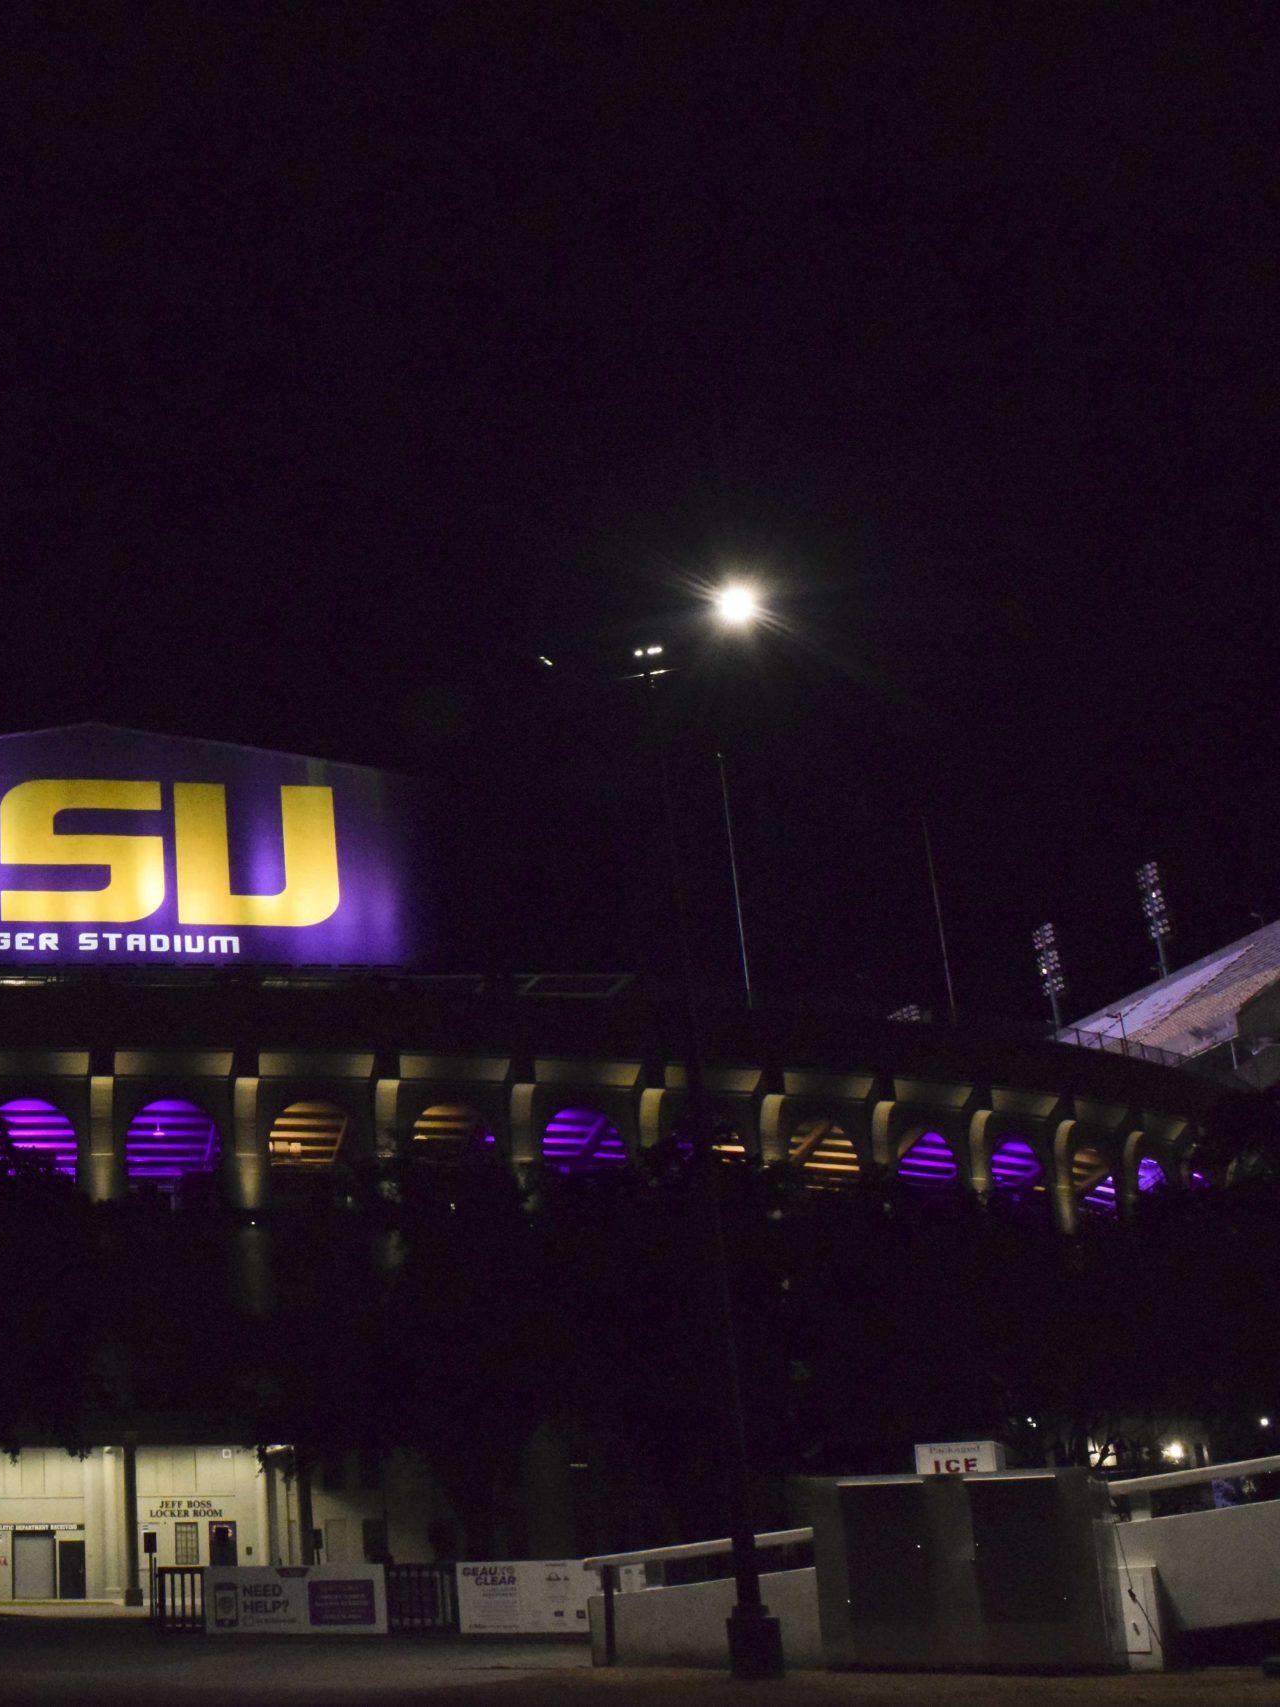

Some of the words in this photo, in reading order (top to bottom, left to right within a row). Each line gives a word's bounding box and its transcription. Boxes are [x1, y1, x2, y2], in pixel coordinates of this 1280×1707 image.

[78, 932, 240, 954] STADIUM
[933, 1458, 978, 1473] ICE
[160, 1500, 183, 1508] JEFF
[187, 1500, 212, 1508] BOSS
[149, 1509, 190, 1517] LOCKER
[193, 1509, 223, 1517] ROOM
[475, 1575, 517, 1586] CLEAR
[243, 1584, 283, 1597] NEED
[243, 1601, 290, 1614] HELP?
